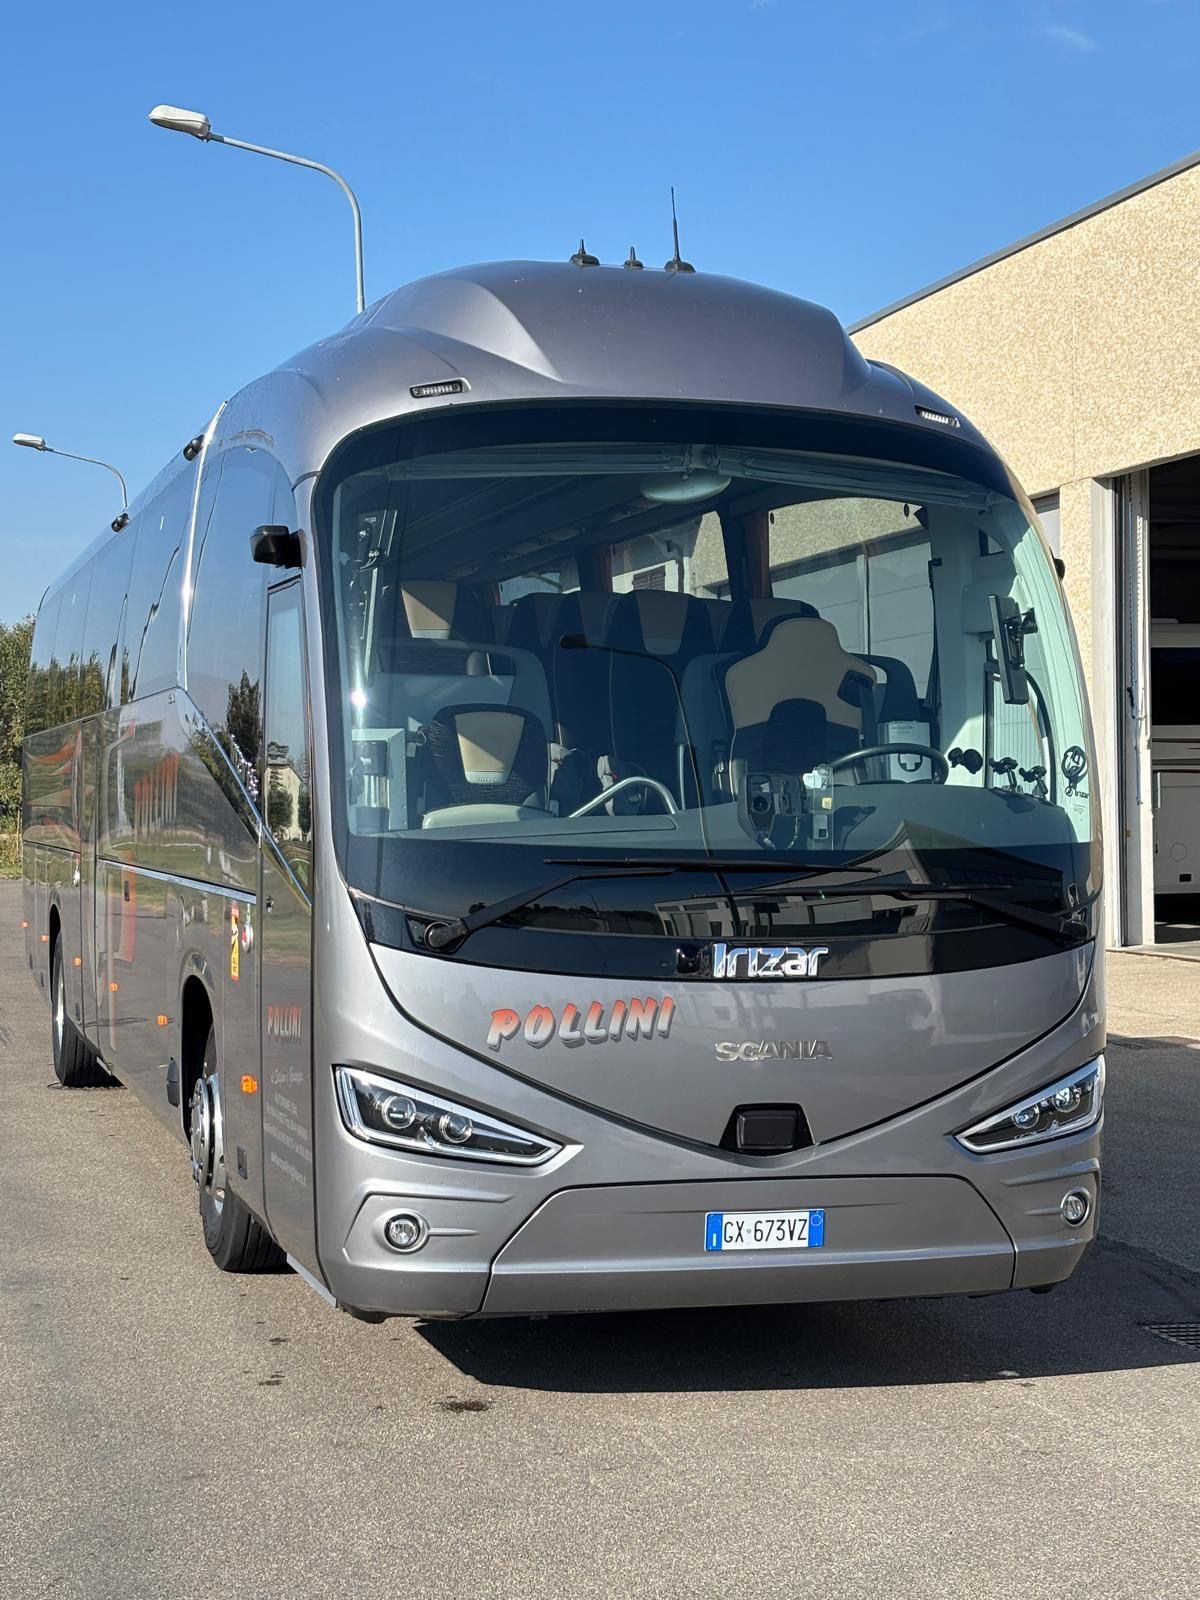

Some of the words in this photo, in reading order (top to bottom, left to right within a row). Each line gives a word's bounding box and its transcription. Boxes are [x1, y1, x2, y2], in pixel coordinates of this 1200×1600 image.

[713, 943, 829, 978] Irizar
[486, 996, 676, 1052] POLLINI
[715, 1040, 833, 1061] SCANIA
[723, 1221, 745, 1243] GX
[753, 1218, 808, 1242] 673VZ
